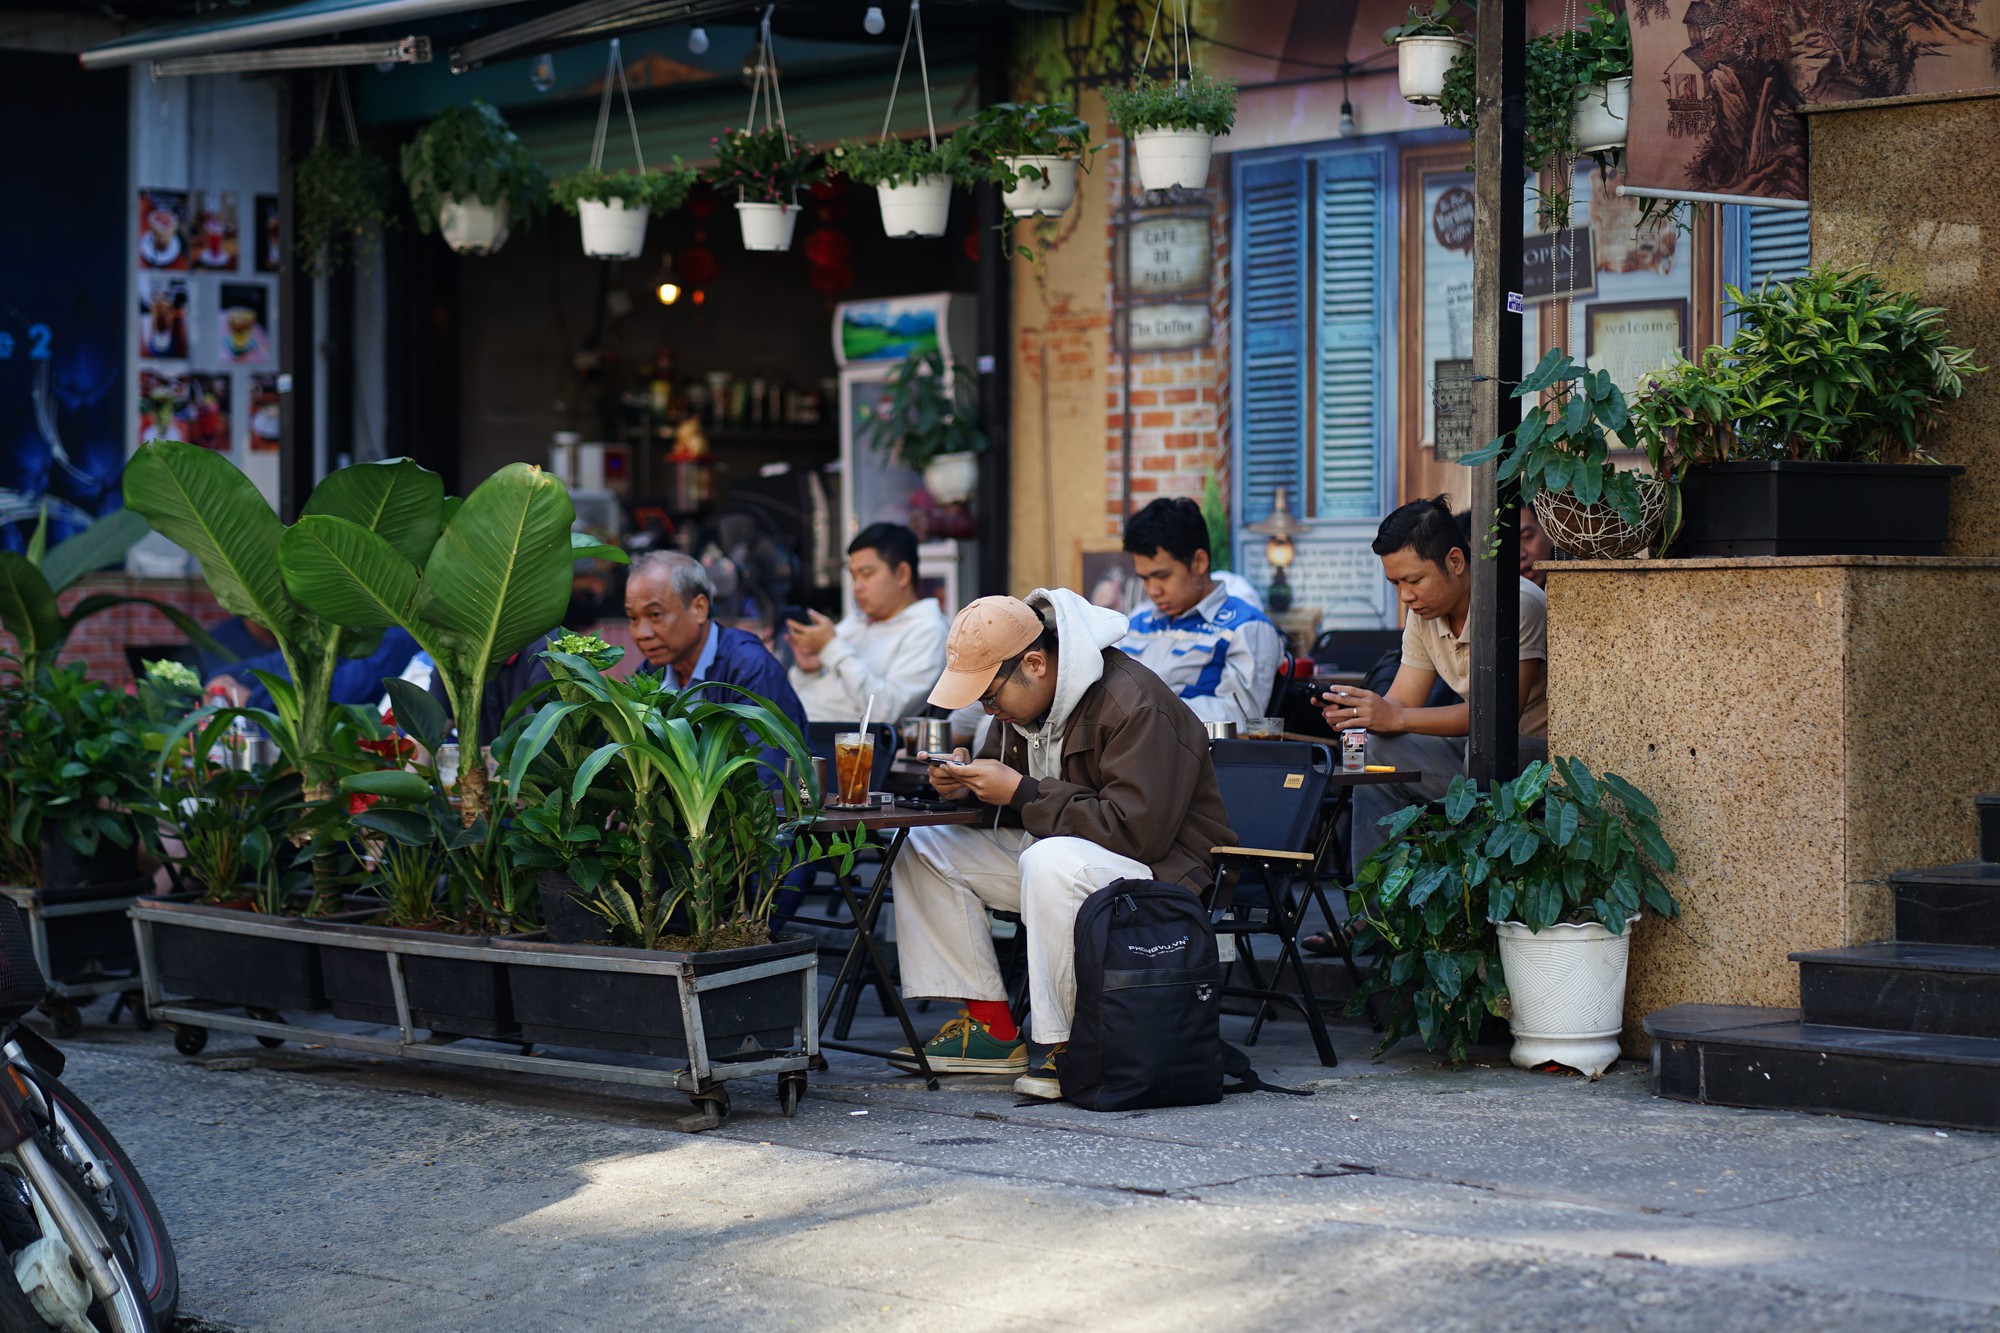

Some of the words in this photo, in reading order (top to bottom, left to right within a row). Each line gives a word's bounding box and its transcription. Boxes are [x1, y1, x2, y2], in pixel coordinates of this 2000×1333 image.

[1523, 243, 1574, 267] OPEN
[1605, 320, 1673, 335] welcome
[28, 322, 52, 360] 2
